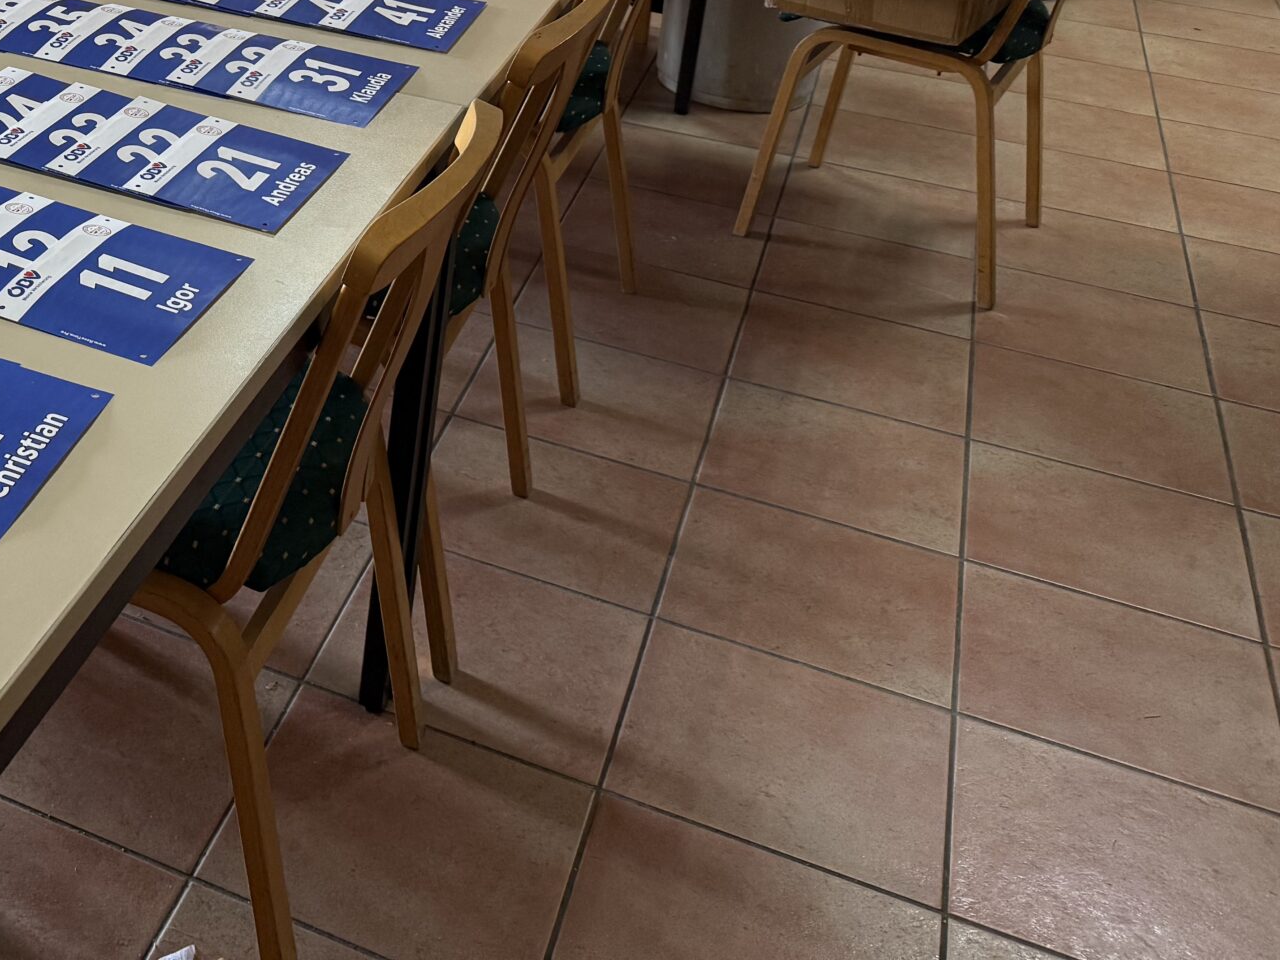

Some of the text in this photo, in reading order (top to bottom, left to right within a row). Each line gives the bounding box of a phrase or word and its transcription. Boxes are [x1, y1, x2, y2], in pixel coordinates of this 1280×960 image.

[425, 5, 467, 39] Alexander
[288, 58, 363, 92] 31
[349, 72, 392, 104] Klaudia
[196, 145, 282, 192] 21
[261, 162, 317, 206] Andreas
[79, 253, 170, 300] 11
[156, 282, 200, 314] Igor
